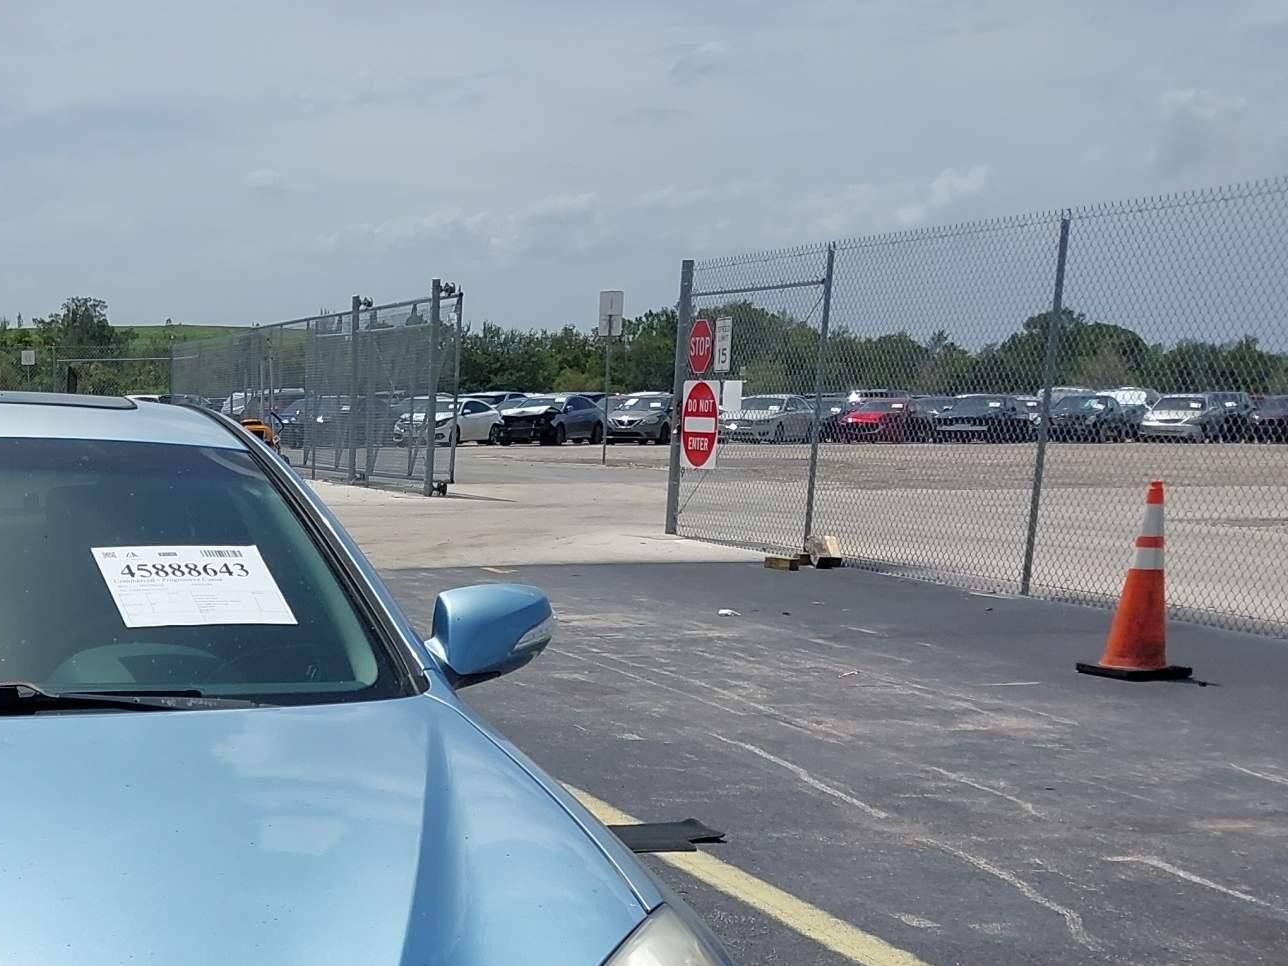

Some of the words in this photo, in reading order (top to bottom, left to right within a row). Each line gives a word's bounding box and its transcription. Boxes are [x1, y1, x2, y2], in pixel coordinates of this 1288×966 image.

[690, 337, 710, 356] STOP
[717, 348, 727, 364] 15
[687, 399, 698, 412] DO
[699, 399, 714, 412] NOT
[687, 437, 708, 451] ENTER
[120, 563, 249, 578] 45888643
